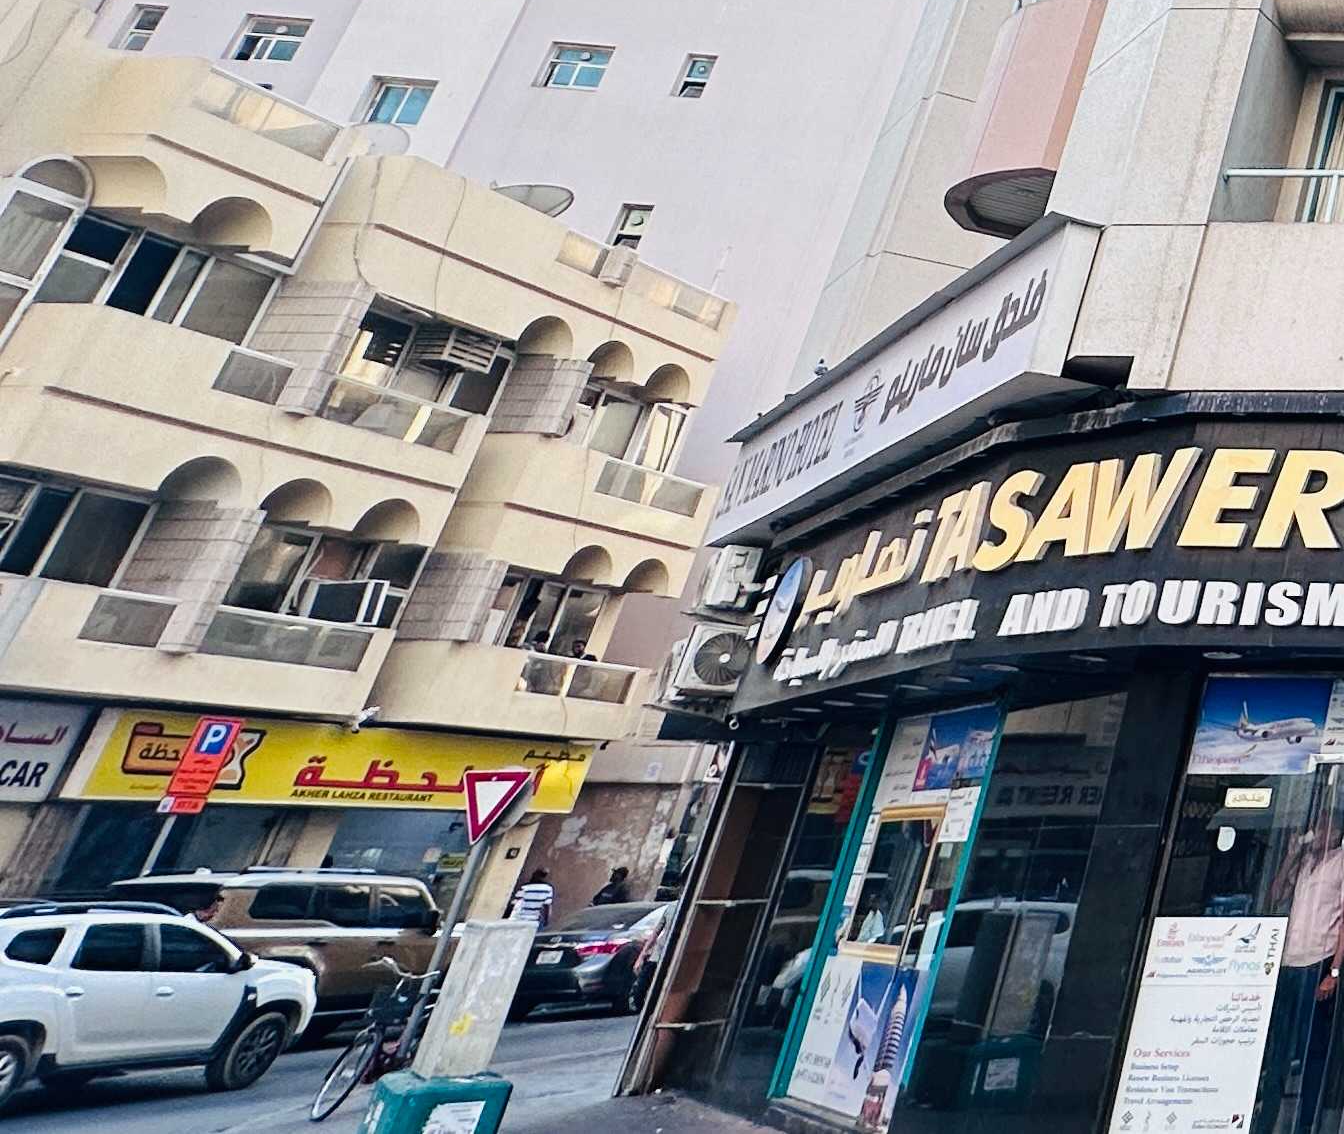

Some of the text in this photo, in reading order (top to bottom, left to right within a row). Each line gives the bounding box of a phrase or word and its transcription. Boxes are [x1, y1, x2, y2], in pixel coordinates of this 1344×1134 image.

[880, 268, 1049, 425] فندق سان مارينو
[997, 585, 1091, 637] AND
[0, 759, 50, 788] CAR
[290, 788, 434, 802] AKHER LAHZA RESTAURANT
[1266, 928, 1280, 959] THAI
[1133, 1048, 1191, 1058] Our Services
